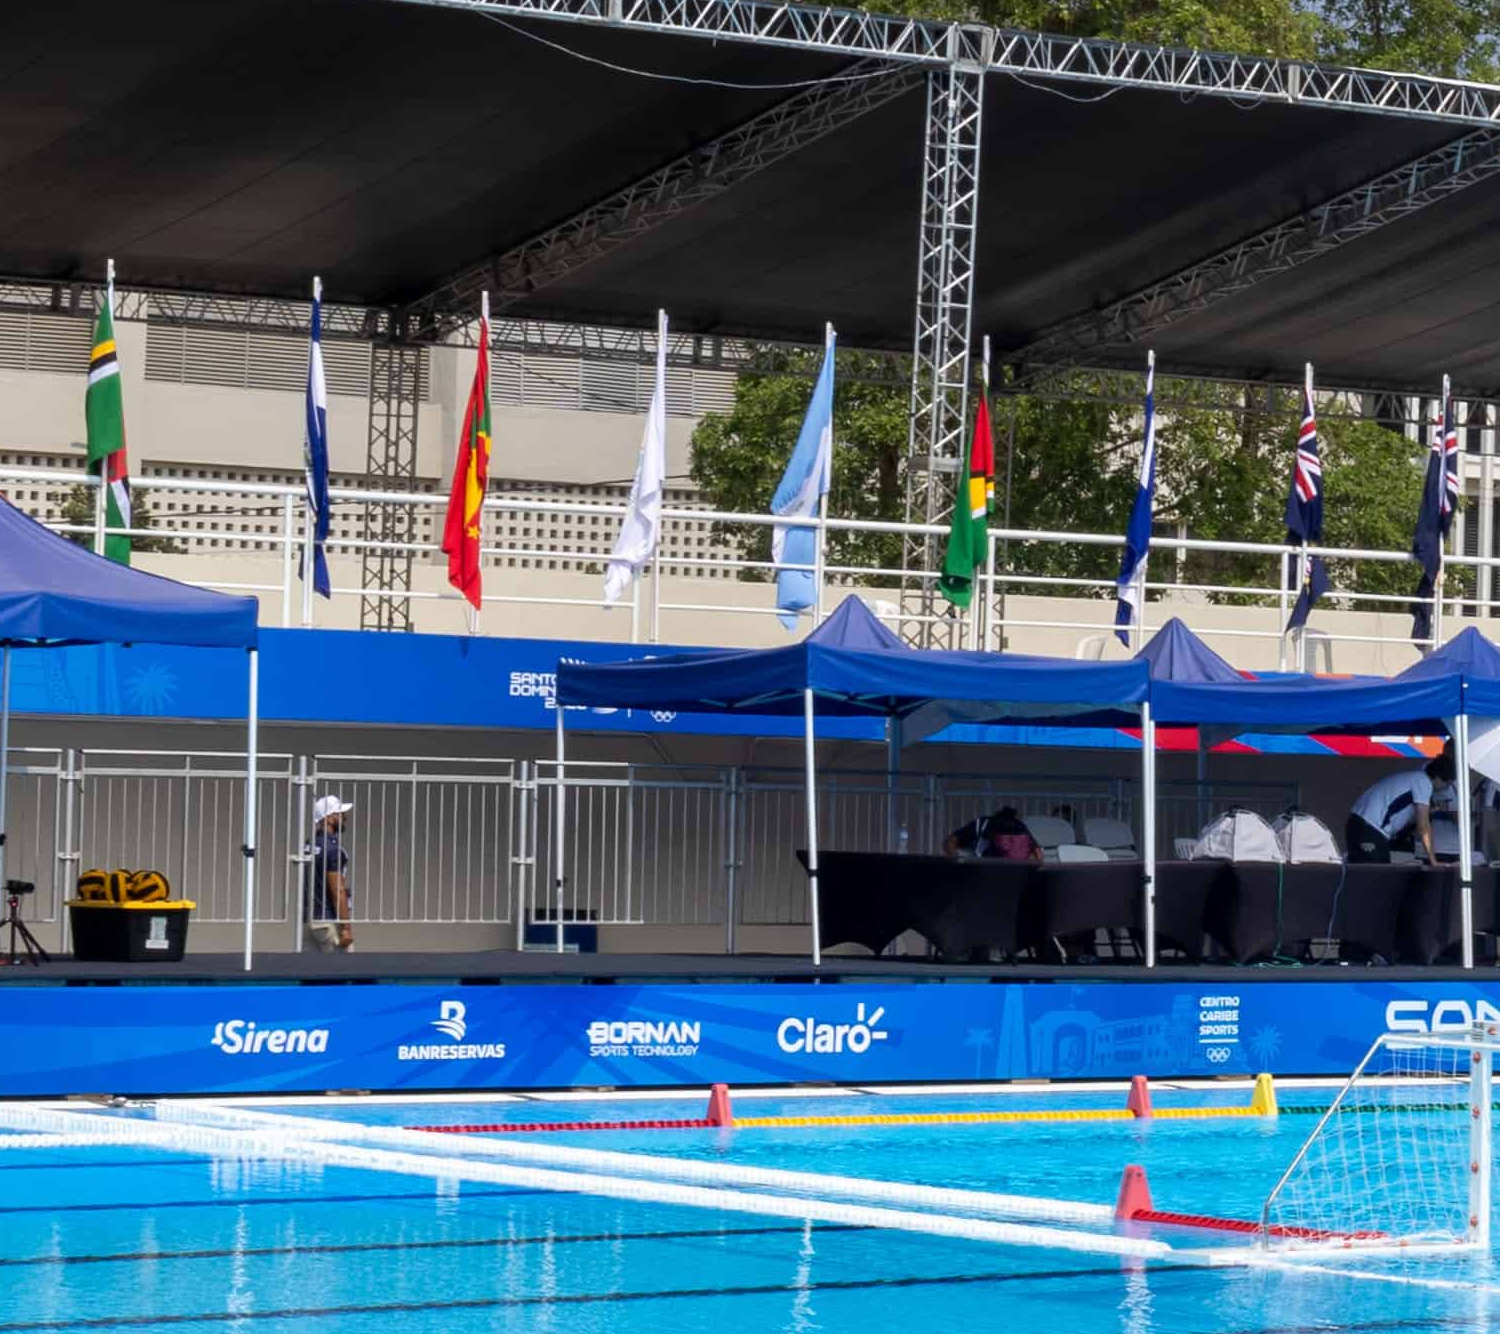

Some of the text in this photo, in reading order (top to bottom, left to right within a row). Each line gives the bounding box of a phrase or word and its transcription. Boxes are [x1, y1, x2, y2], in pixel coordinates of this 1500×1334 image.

[509, 685, 557, 697] DOMIN
[220, 1019, 329, 1054] Sirena
[587, 1021, 701, 1044] BORNAN
[777, 1016, 874, 1053] Claro
[398, 1044, 506, 1060] BANRESERVAS
[590, 1045, 699, 1057] SPORTS TECHNOLOGY
